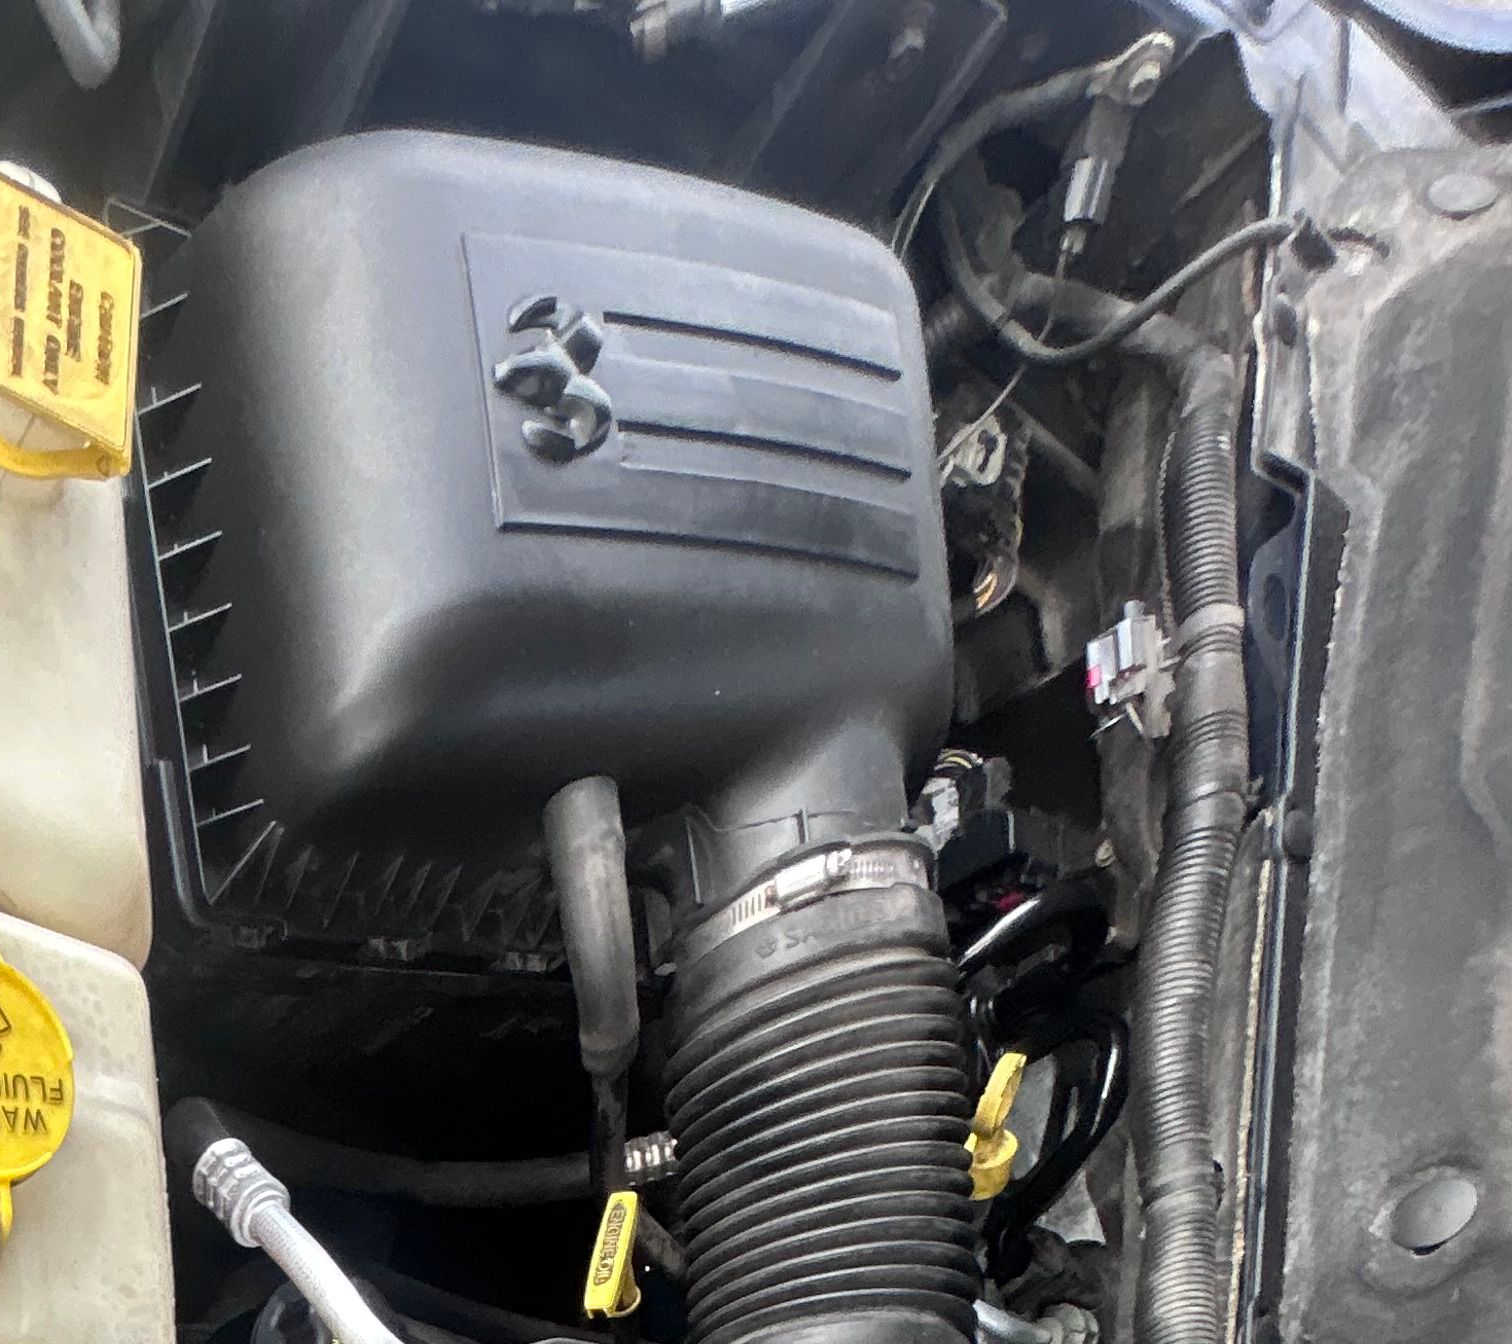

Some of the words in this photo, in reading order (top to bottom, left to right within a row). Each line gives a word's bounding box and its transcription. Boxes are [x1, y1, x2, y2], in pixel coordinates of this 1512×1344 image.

[46, 228, 66, 330] COOLANT
[42, 335, 61, 396] ONLY
[600, 1208, 628, 1258] ENGINE
[592, 1257, 615, 1286] OIL
